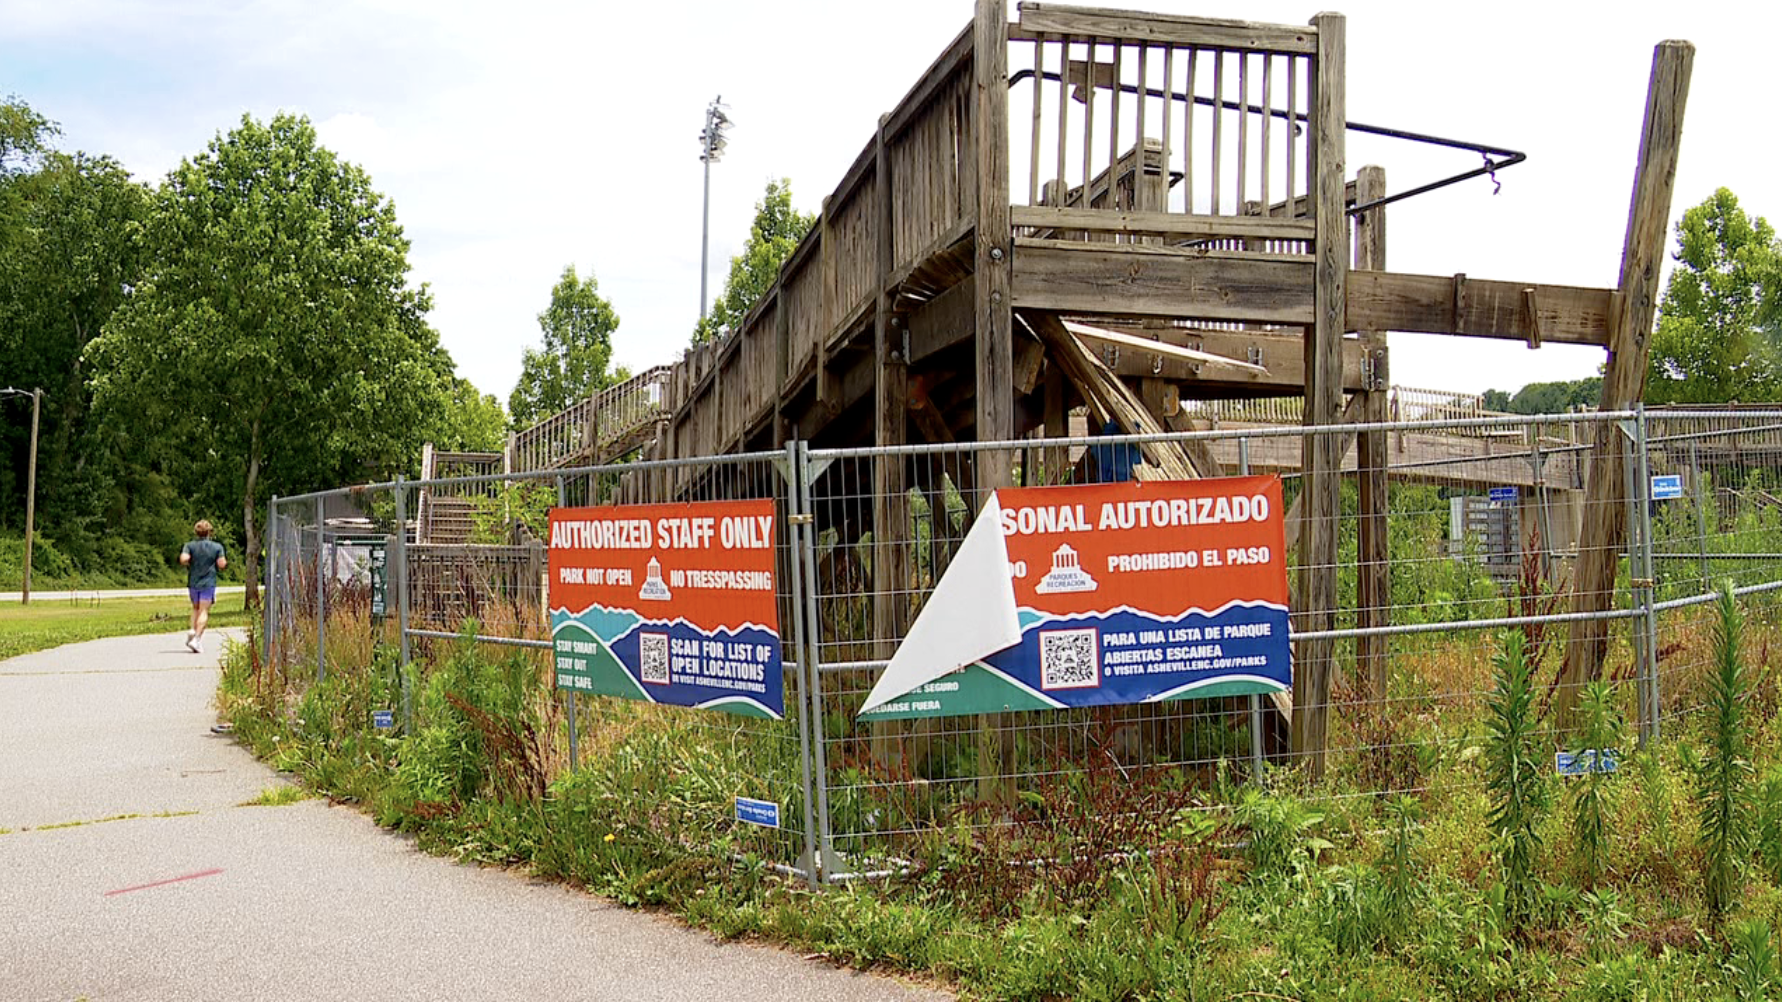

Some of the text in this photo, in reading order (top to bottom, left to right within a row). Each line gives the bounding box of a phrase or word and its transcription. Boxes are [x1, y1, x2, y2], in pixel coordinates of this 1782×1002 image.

[1001, 494, 1269, 536] SONAL AUTORIZADO
[550, 515, 773, 549] AUTHORIZED STAFF ONLY
[1107, 546, 1270, 573] PROHIBIDO EL PASO
[560, 567, 632, 586] PARK NOT OPEN
[670, 569, 772, 590] NO TRESSPASSING
[1049, 572, 1078, 580] PARQUES
[1103, 623, 1271, 647] PARA UNA LISTA DE PARQUE
[574, 641, 597, 655] SMART
[671, 638, 772, 662] SCAN FOR LIST OF
[1104, 644, 1223, 665] ABIERTAS ESCANEA
[557, 657, 587, 671] STAY OUT
[671, 656, 764, 681] OPEN LOCATIONS
[1104, 656, 1267, 677] O VISITA ASHEVILLENC.GOV/PARKS
[558, 673, 593, 689] STAY SAFE
[680, 675, 695, 684] VISIT
[924, 682, 959, 693] SEGURO
[912, 700, 941, 711] FUERA
